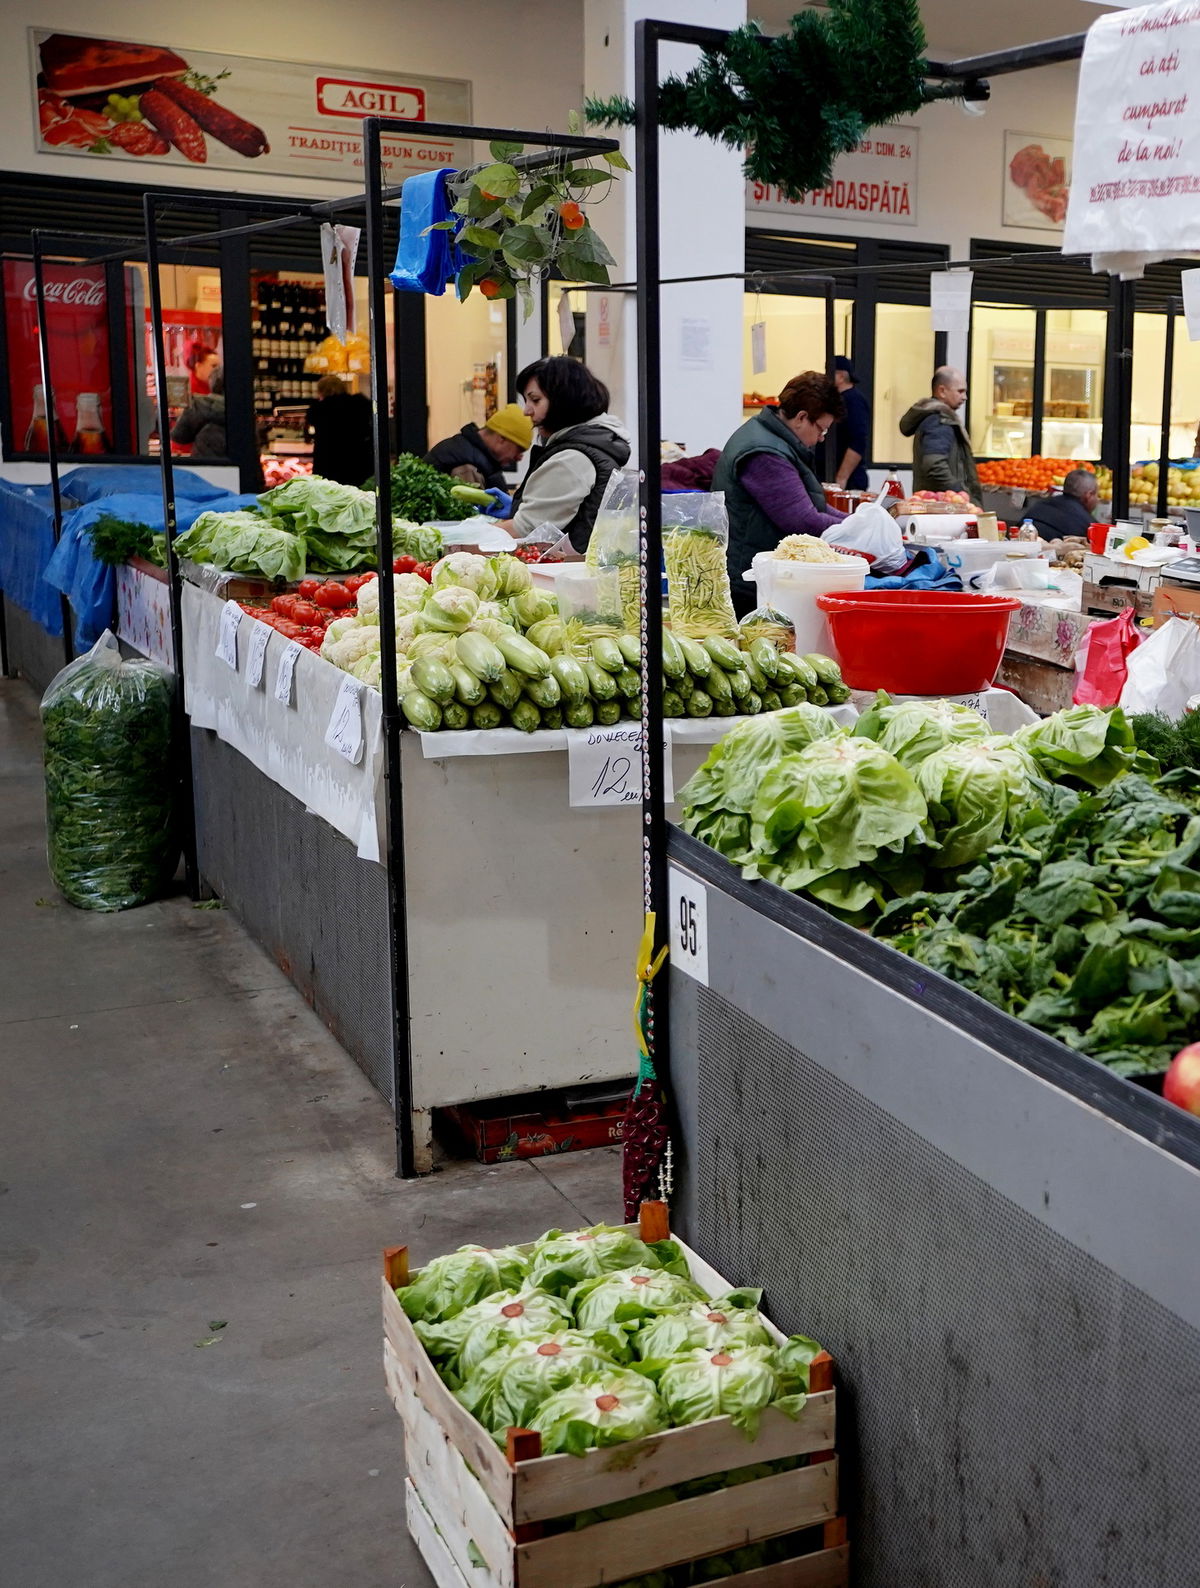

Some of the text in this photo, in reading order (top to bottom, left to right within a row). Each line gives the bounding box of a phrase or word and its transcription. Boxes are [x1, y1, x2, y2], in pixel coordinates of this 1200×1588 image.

[341, 89, 405, 113] AGIL
[383, 146, 412, 159] BUN
[417, 150, 455, 163] GUST
[900, 144, 911, 159] 24
[1117, 140, 1132, 163] de
[591, 756, 631, 798] 12
[680, 895, 697, 957] 95
